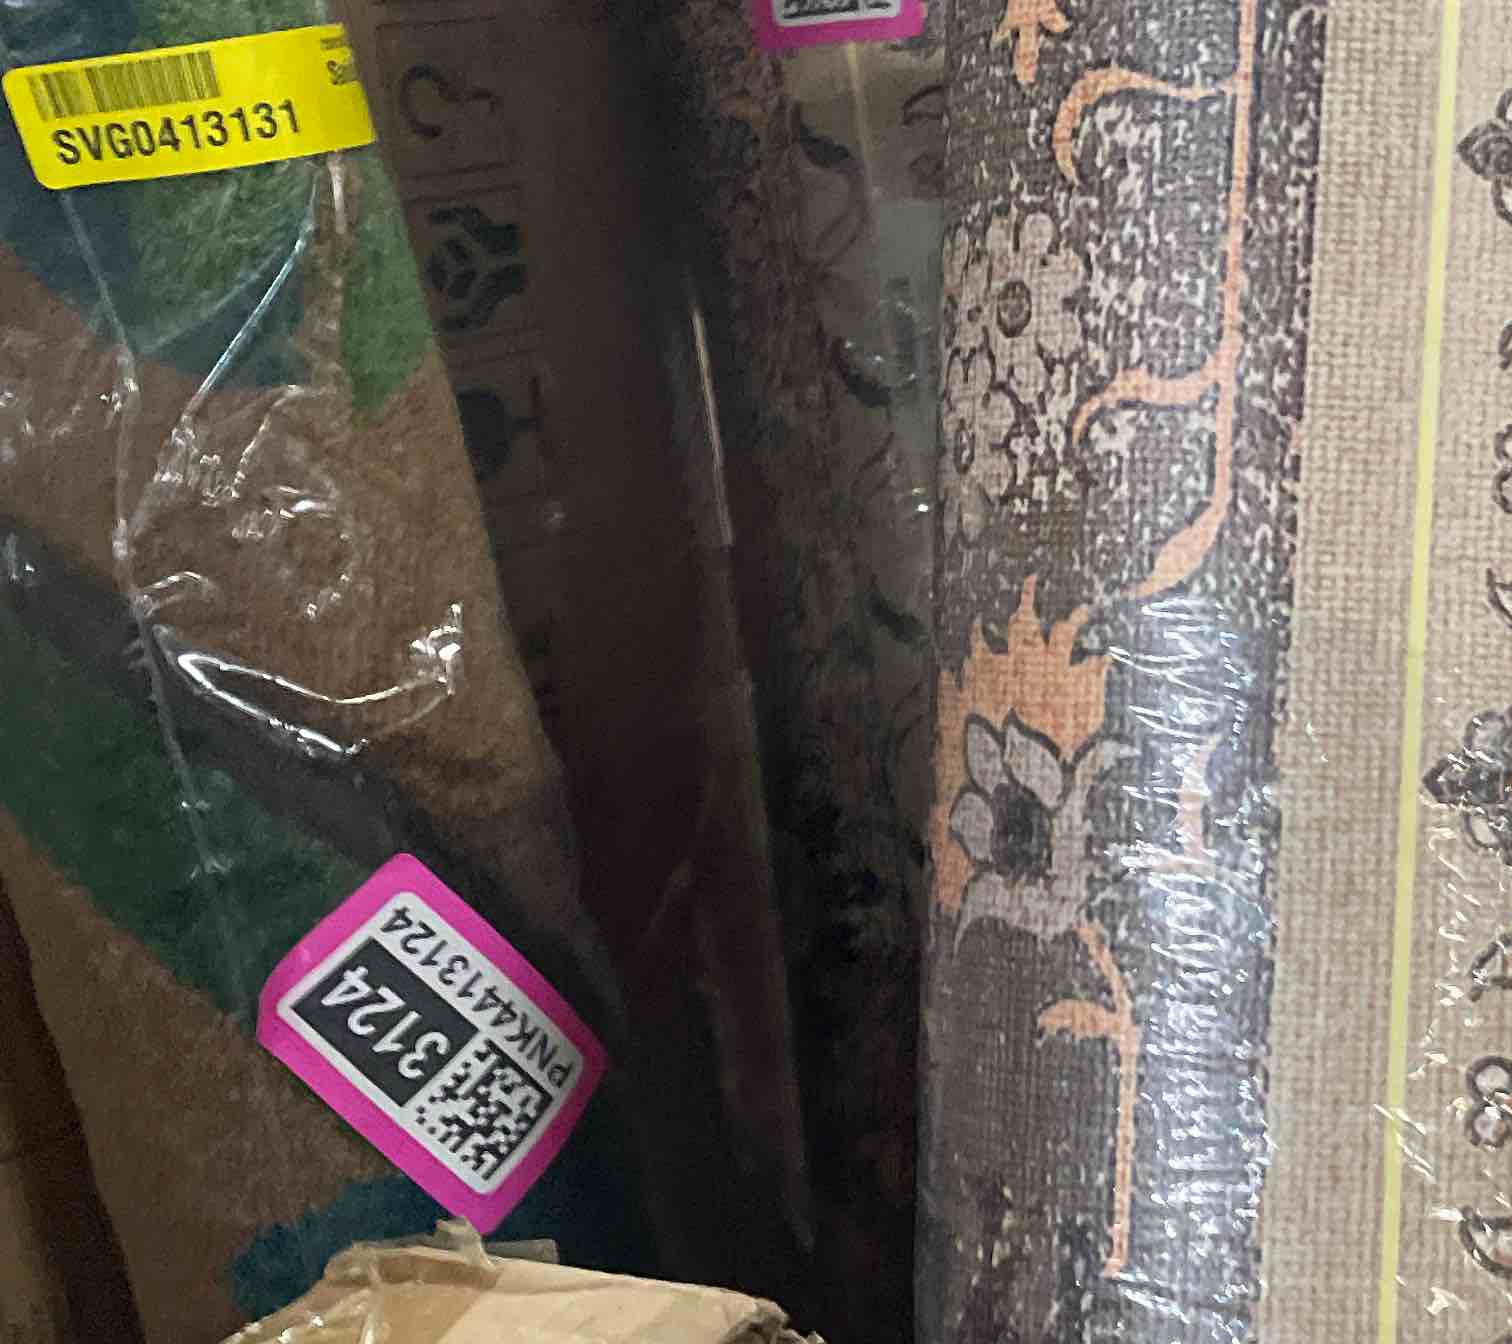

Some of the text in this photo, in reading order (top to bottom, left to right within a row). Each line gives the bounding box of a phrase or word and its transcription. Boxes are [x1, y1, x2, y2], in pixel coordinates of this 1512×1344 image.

[51, 99, 300, 165] SVG0413131
[321, 964, 450, 1080] 3124
[380, 905, 574, 1089] PNK4413124
